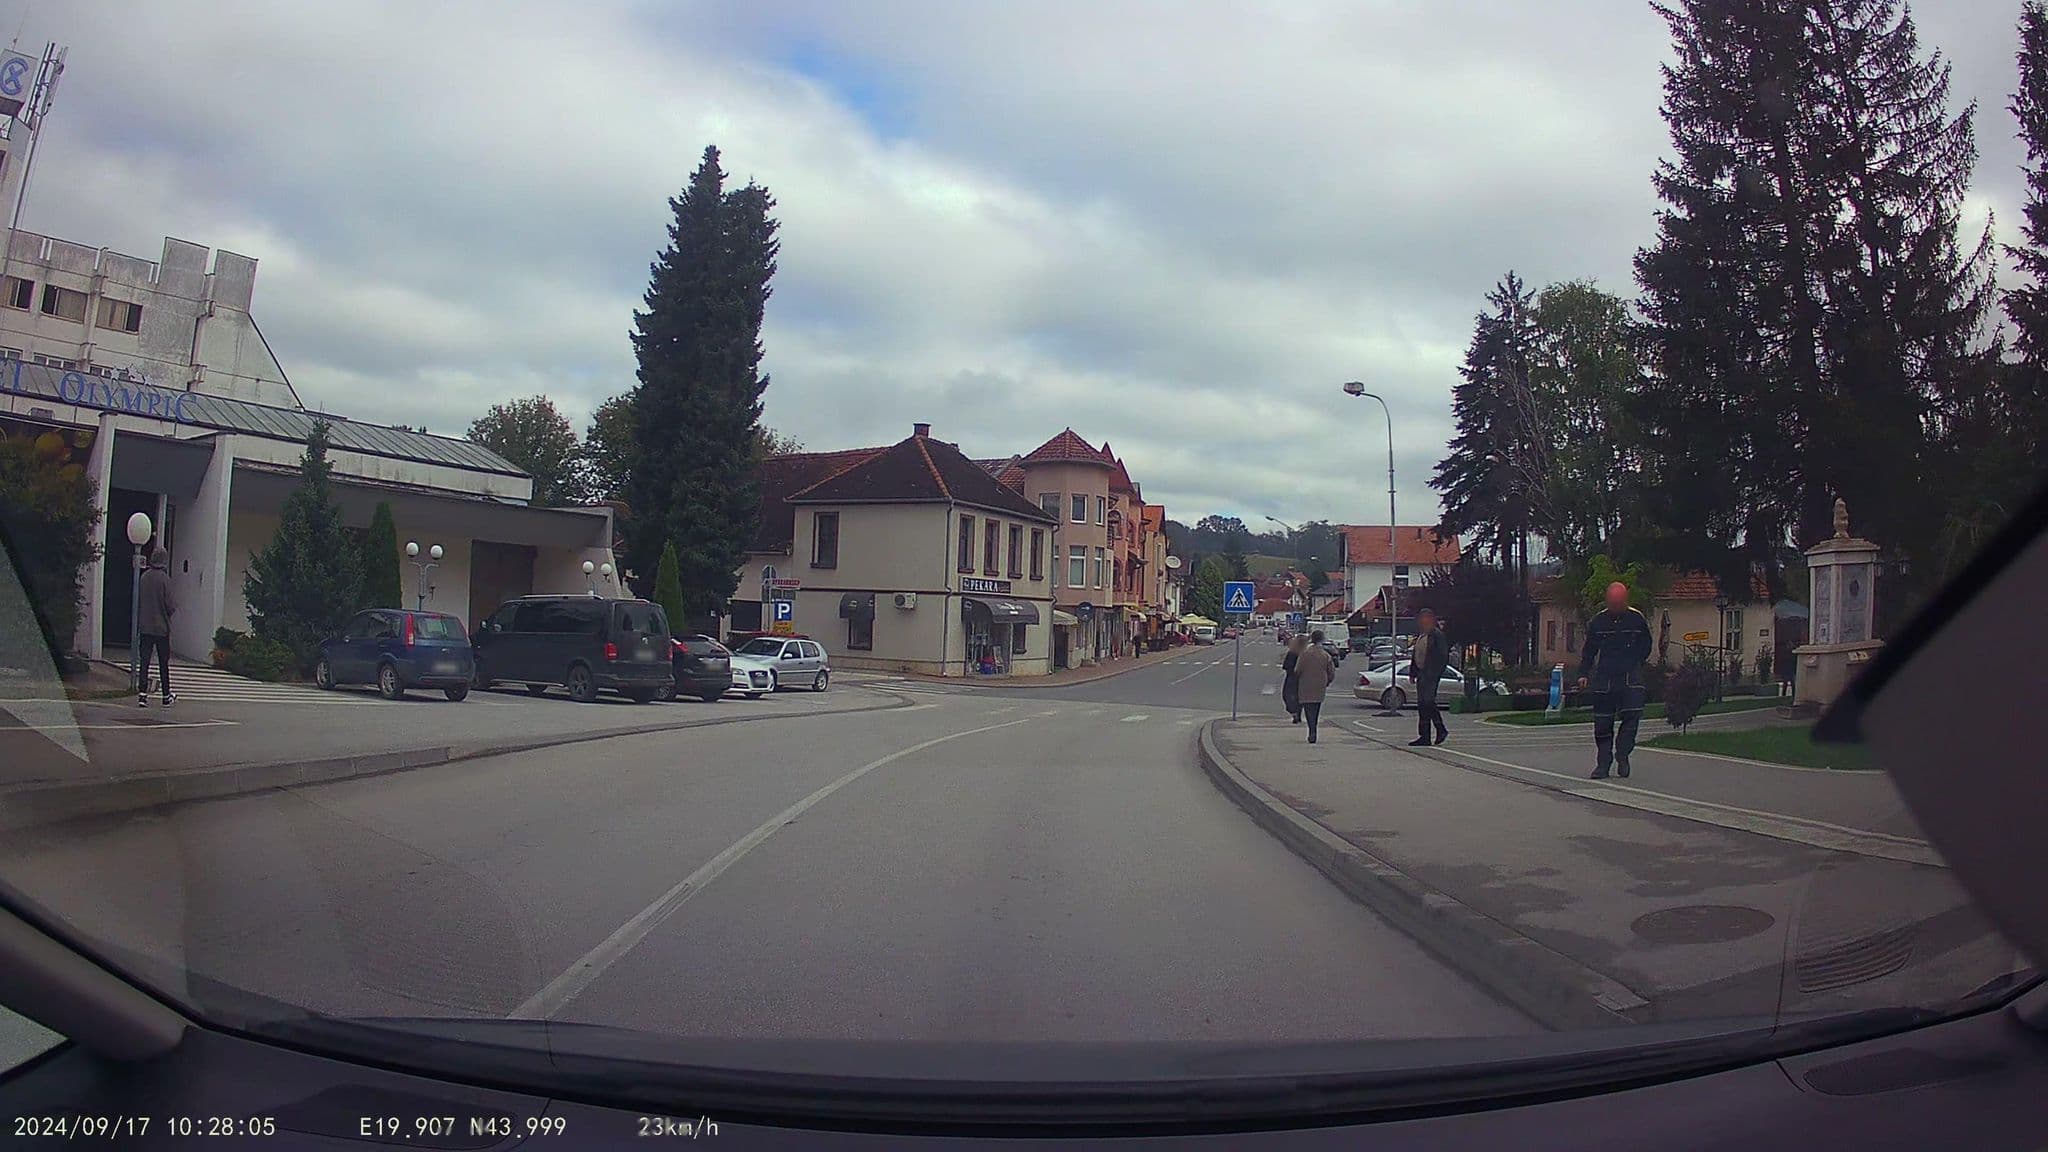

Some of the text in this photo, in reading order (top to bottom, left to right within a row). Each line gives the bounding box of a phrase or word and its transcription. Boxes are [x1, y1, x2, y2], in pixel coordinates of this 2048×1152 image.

[60, 372, 199, 423] OLYMPIC
[970, 579, 999, 592] PEKARA
[777, 603, 791, 620] P
